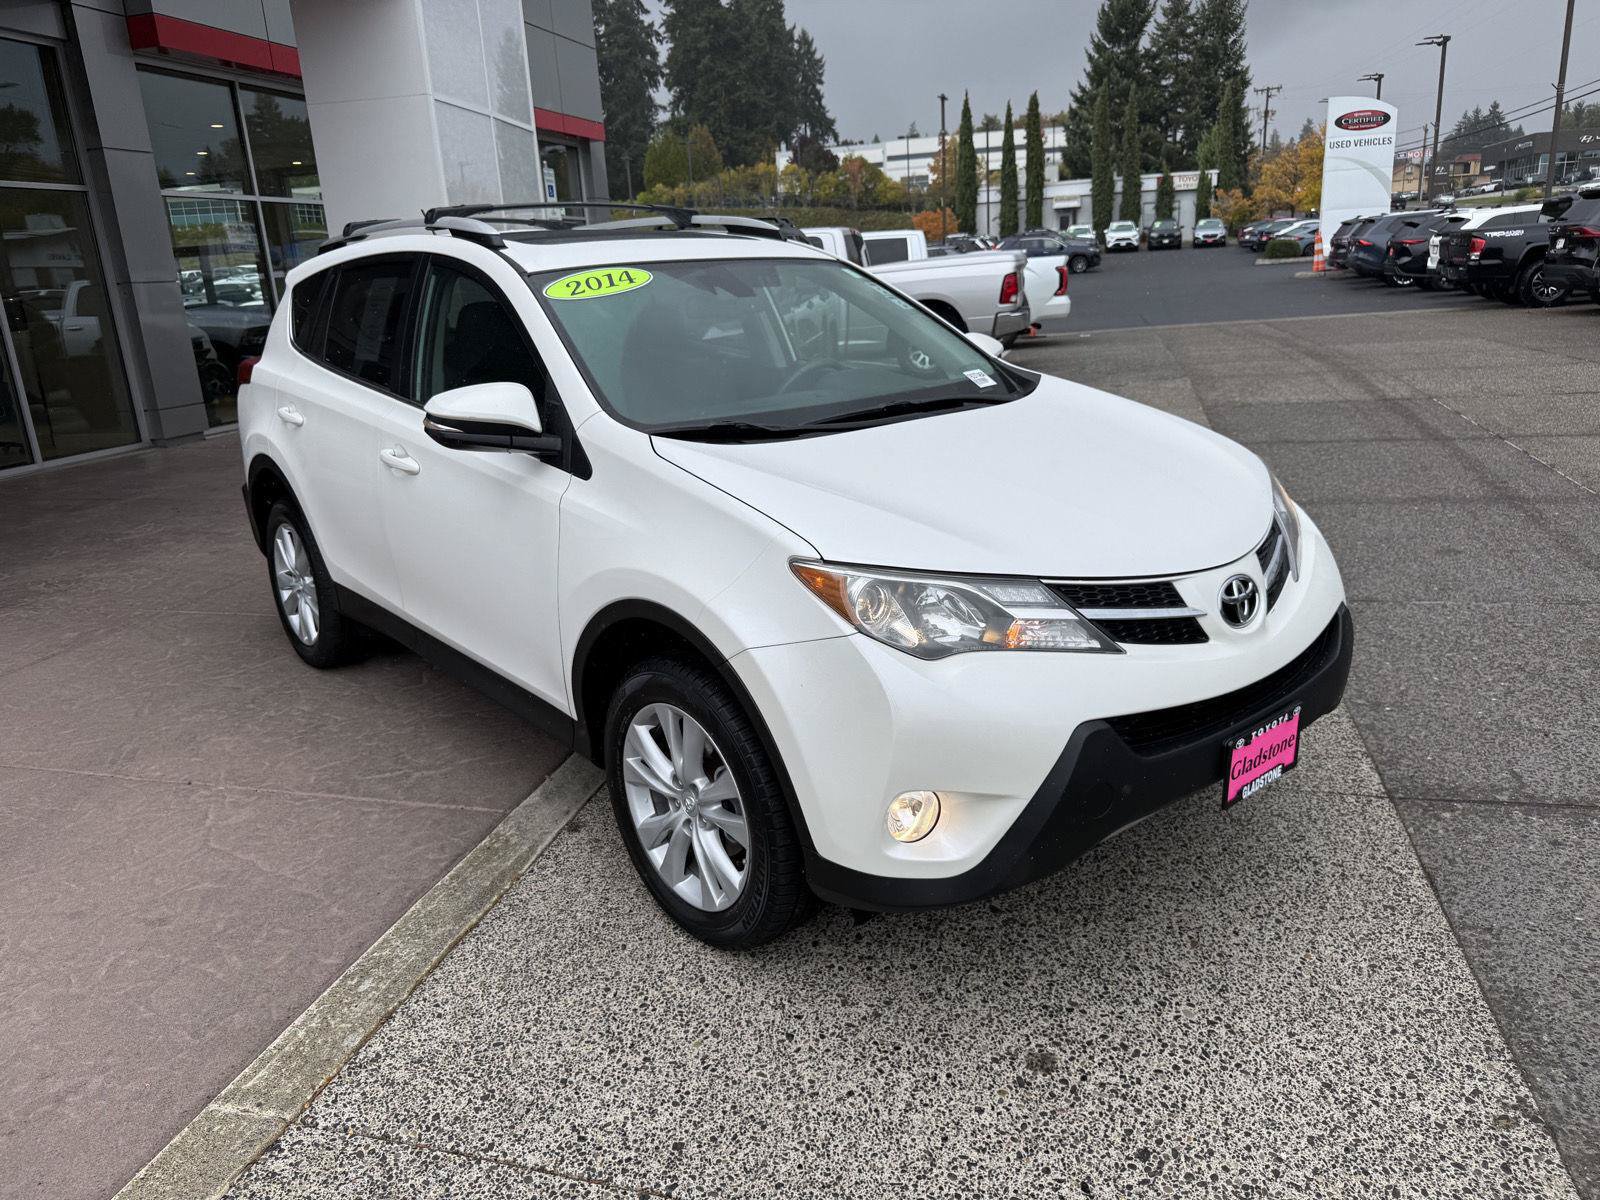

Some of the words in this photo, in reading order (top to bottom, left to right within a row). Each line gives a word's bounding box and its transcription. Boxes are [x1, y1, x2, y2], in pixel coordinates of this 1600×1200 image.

[1341, 115, 1384, 125] CERTIFIED
[1329, 140, 1352, 150] USED
[1354, 136, 1393, 148] VEHICLES
[565, 270, 637, 296] 2014
[1251, 712, 1289, 740] TOYOTA
[1231, 734, 1295, 781] Gladstone
[1242, 764, 1283, 800] GLADSTONE
